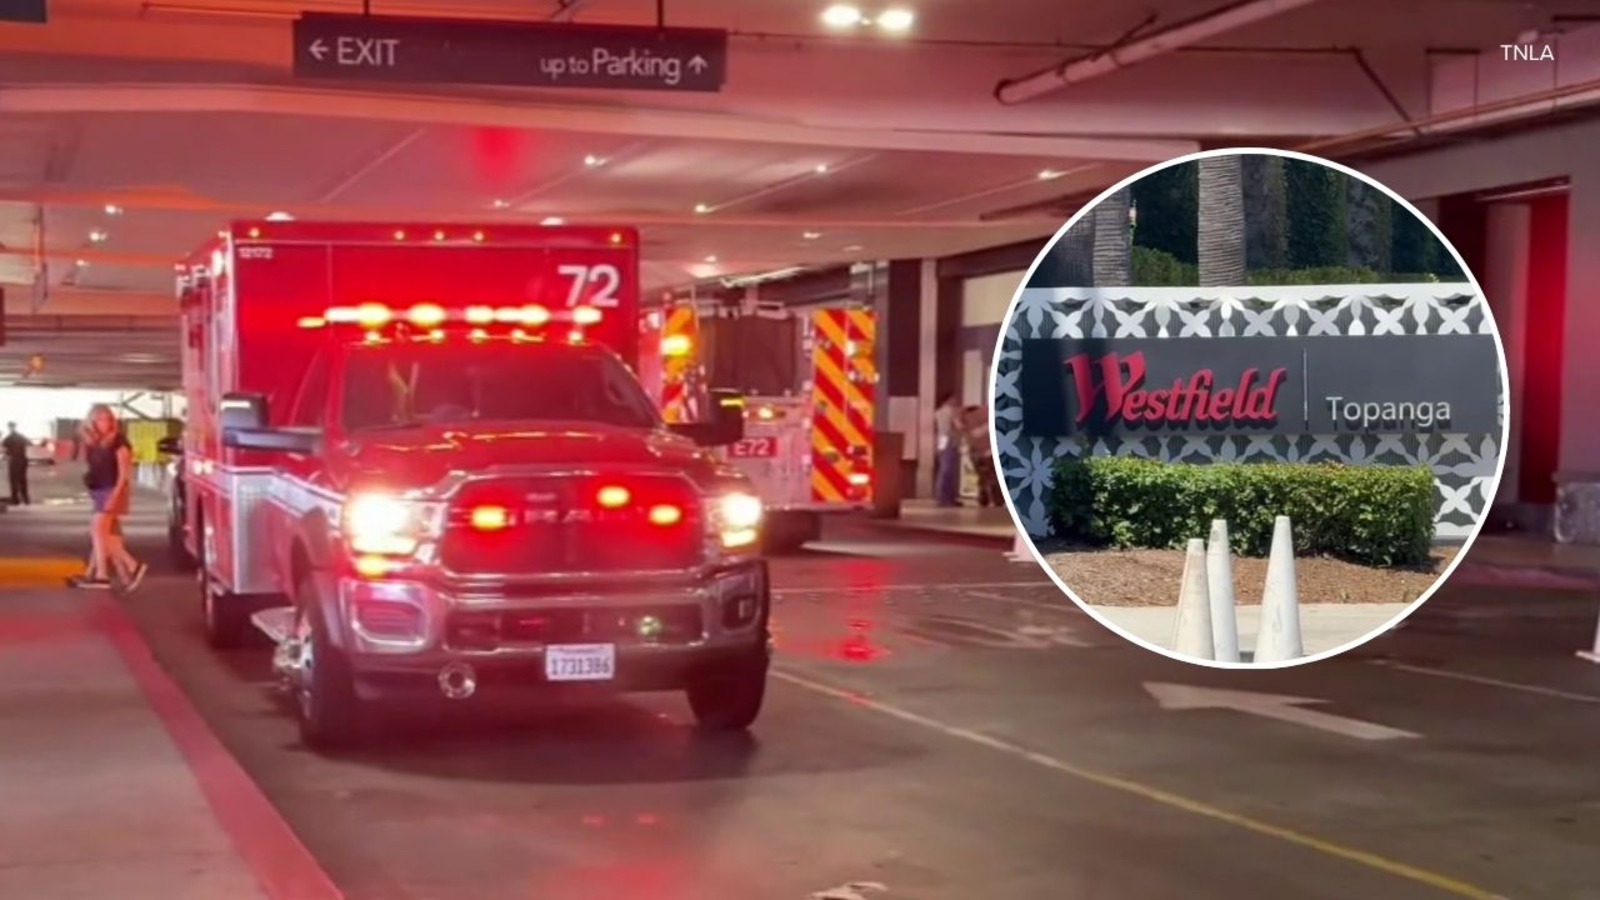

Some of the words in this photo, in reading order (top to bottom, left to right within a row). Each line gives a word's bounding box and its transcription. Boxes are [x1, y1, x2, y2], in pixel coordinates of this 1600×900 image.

[337, 36, 399, 66] EXIT
[540, 57, 566, 80] up
[568, 56, 589, 74] to
[592, 47, 681, 85] Parking
[558, 264, 620, 308] 72
[1063, 350, 1288, 422] Westfield
[1325, 396, 1451, 428] Topanga
[734, 438, 769, 456] E72
